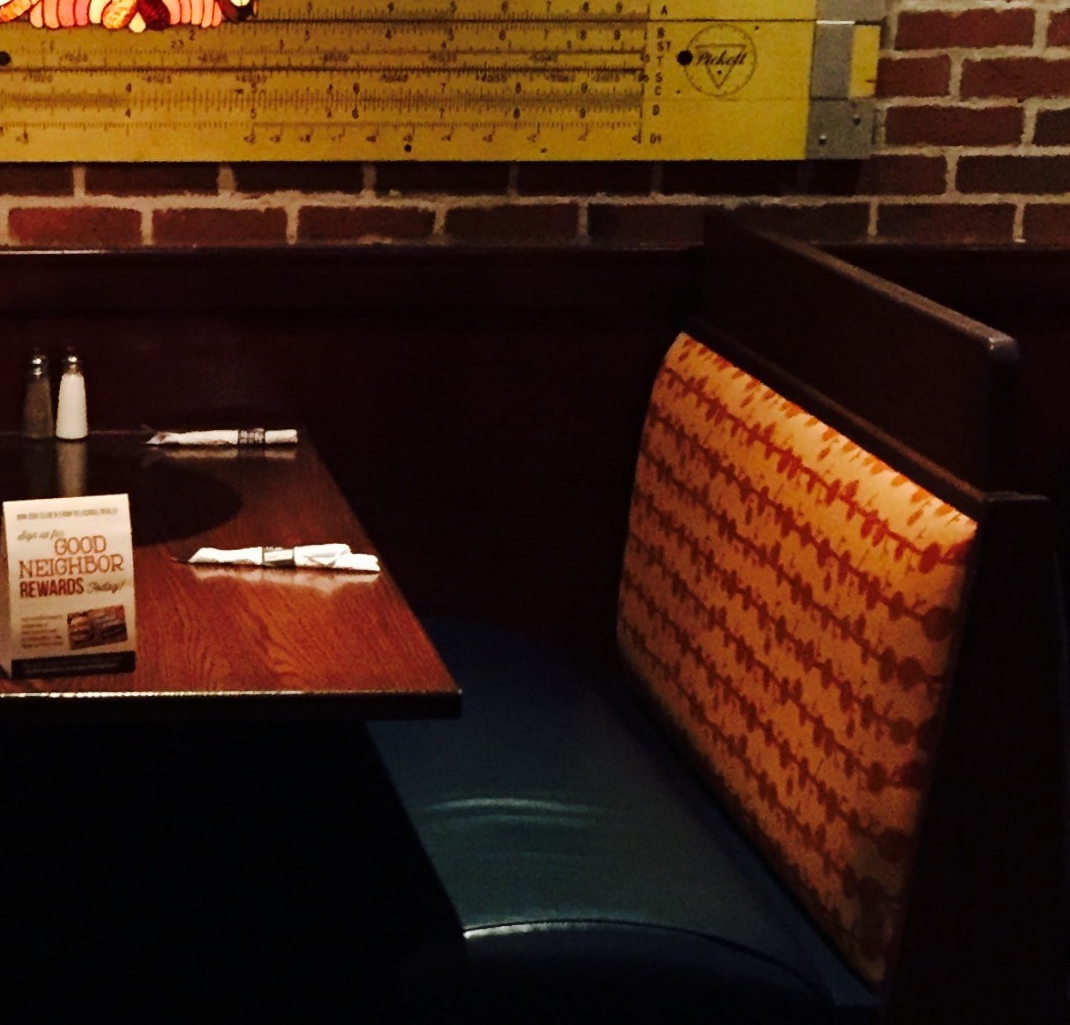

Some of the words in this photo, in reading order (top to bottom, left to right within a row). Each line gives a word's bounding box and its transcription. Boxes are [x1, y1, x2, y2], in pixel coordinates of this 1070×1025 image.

[695, 49, 748, 67] Pickett
[654, 85, 662, 96] C
[54, 535, 107, 556] GOOD
[18, 553, 125, 579] NEIGHBOR
[19, 576, 85, 599] REWARDS
